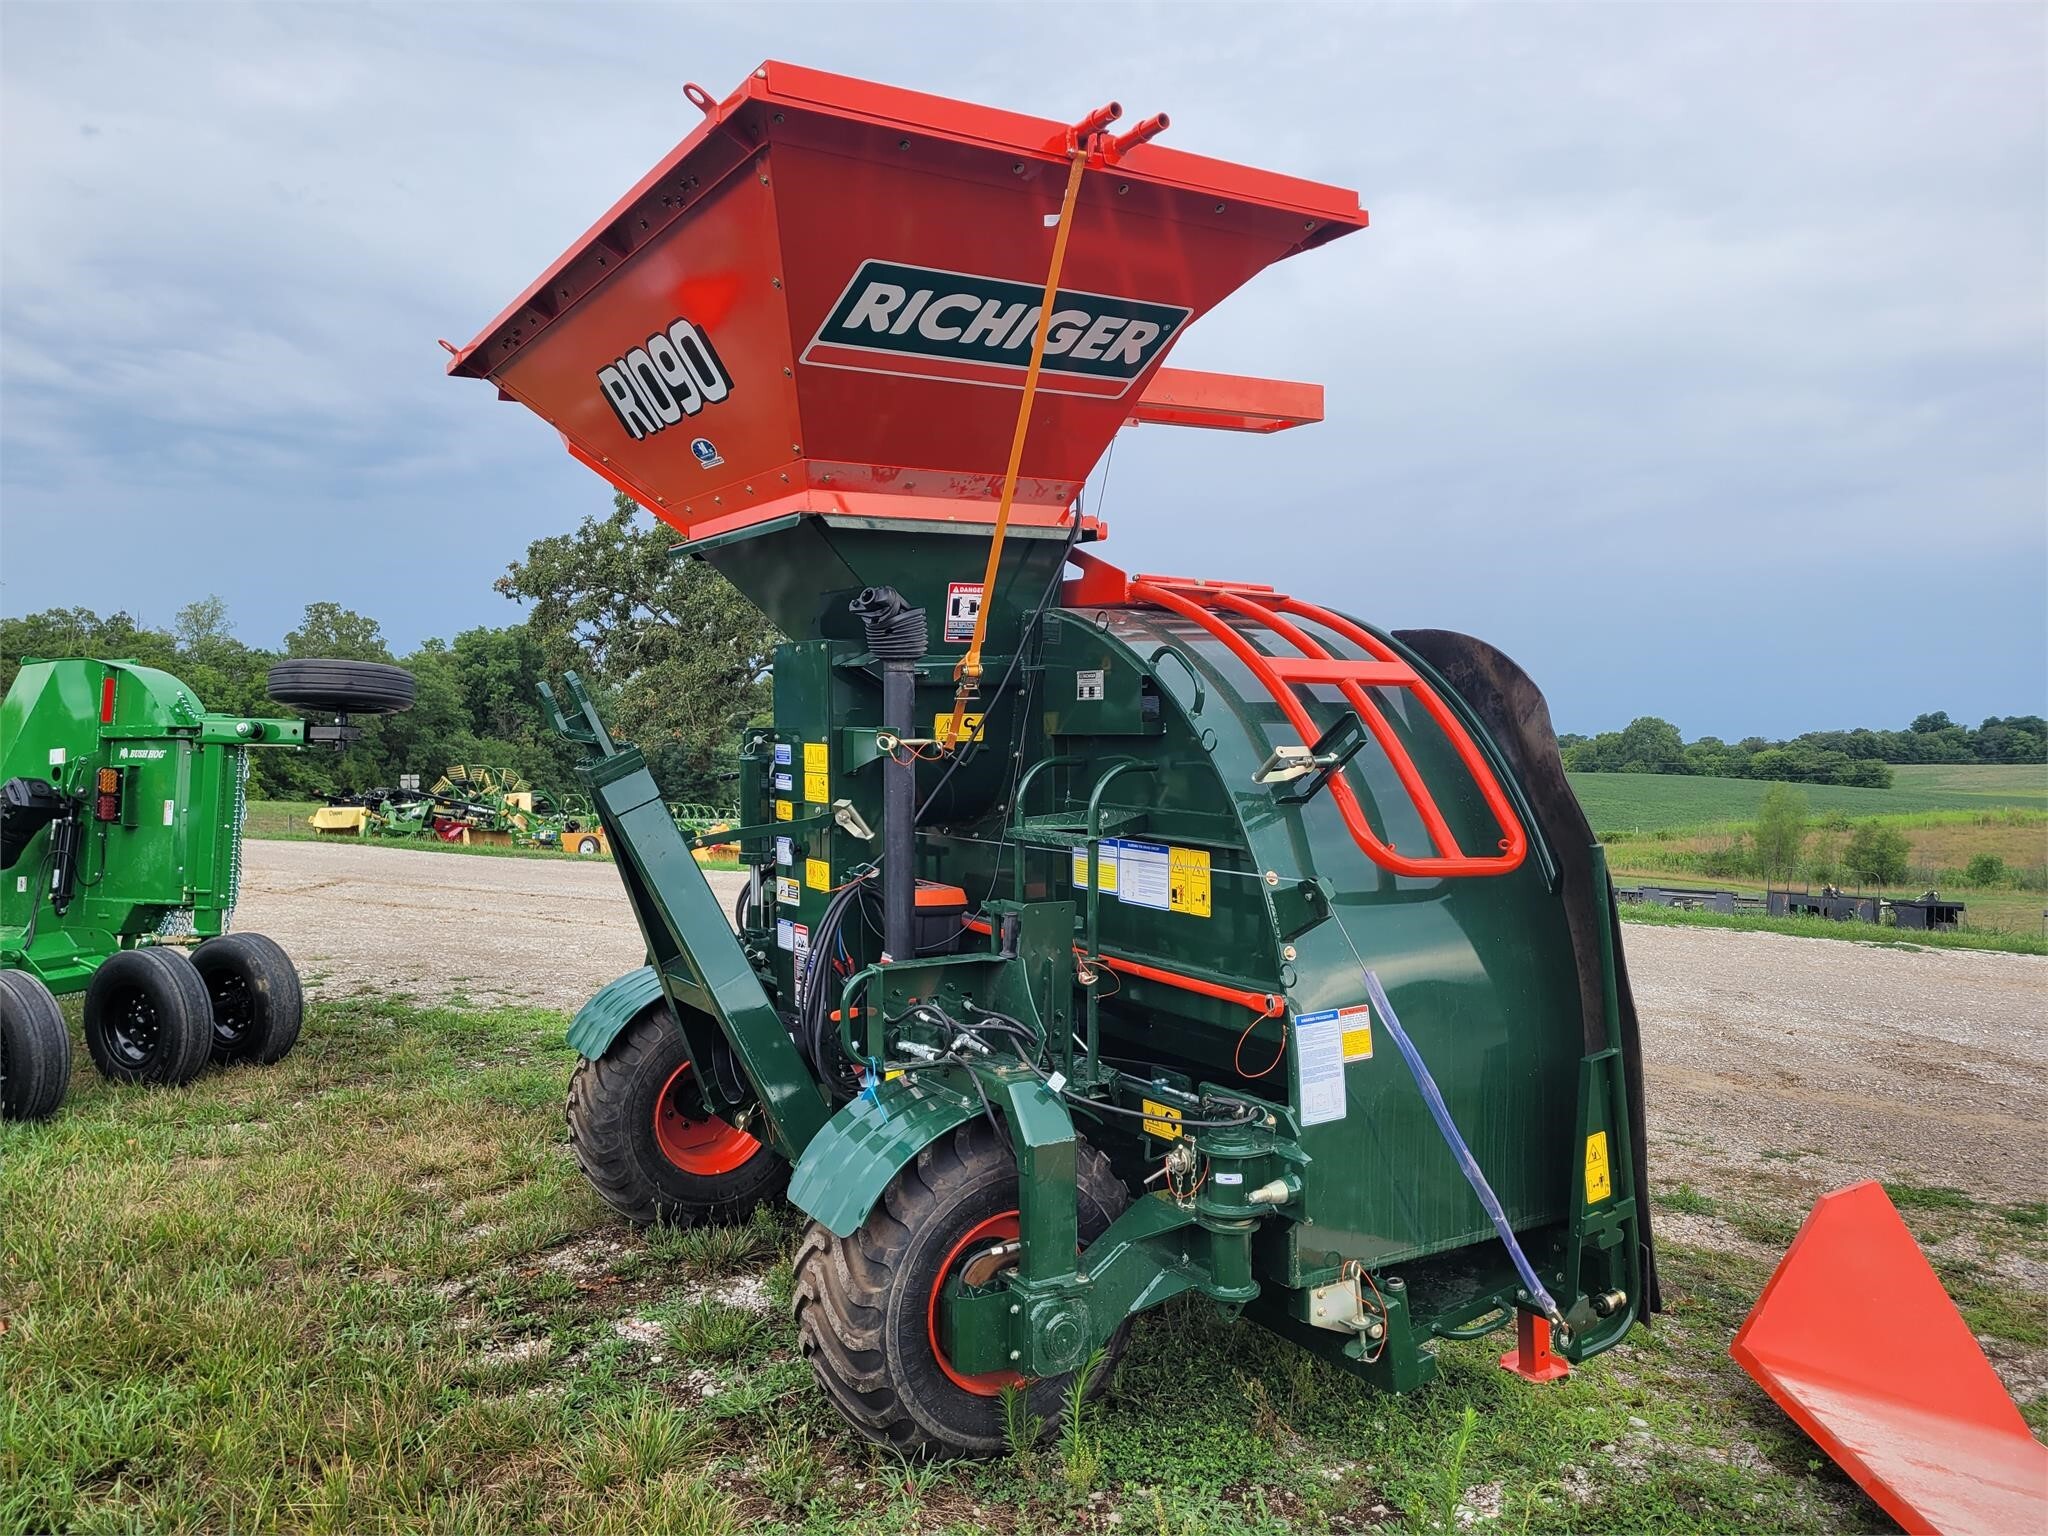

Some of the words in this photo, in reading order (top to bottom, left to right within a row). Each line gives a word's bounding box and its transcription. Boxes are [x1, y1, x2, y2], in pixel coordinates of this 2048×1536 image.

[841, 281, 1161, 365] RICHIGER
[129, 749, 148, 759] BUSH
[147, 749, 165, 759] HOG
